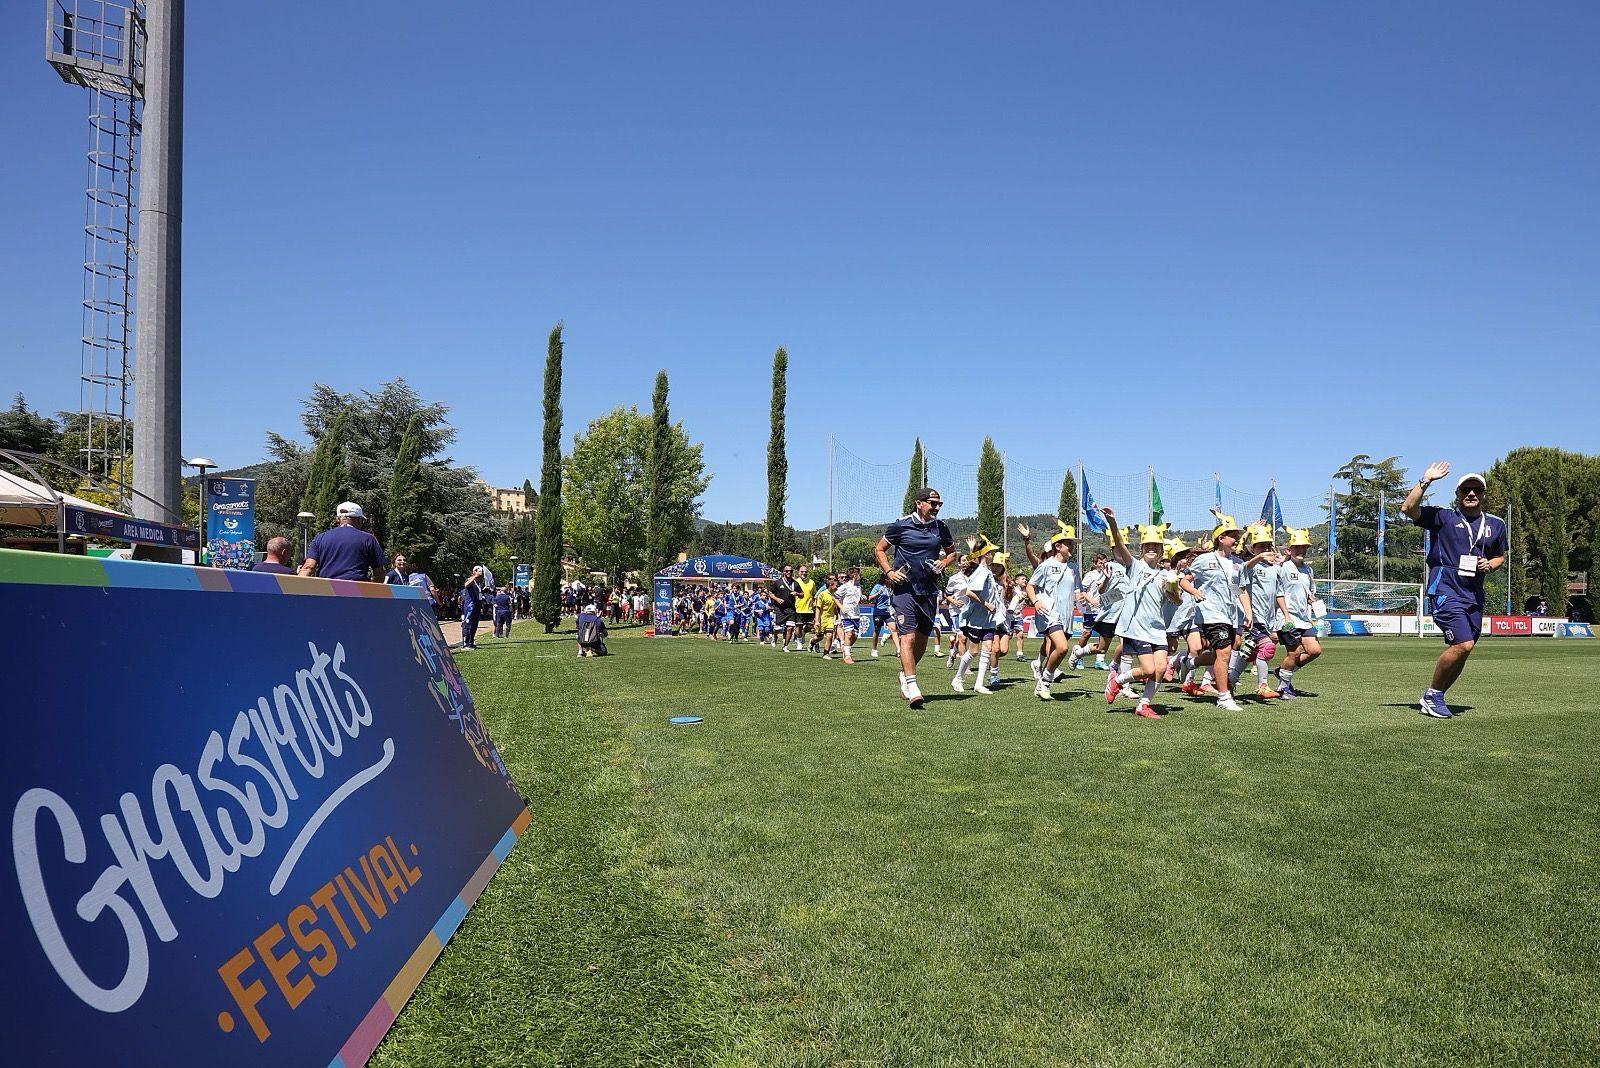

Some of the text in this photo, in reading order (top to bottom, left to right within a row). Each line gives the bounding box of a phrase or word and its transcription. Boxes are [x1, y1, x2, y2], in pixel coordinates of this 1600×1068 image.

[123, 523, 139, 539] AREA
[139, 527, 164, 541] MEDICA
[1496, 621, 1511, 630] TCL
[1514, 621, 1528, 630] TCL
[1539, 622, 1556, 632] CAME
[12, 641, 374, 1014] Grassroots
